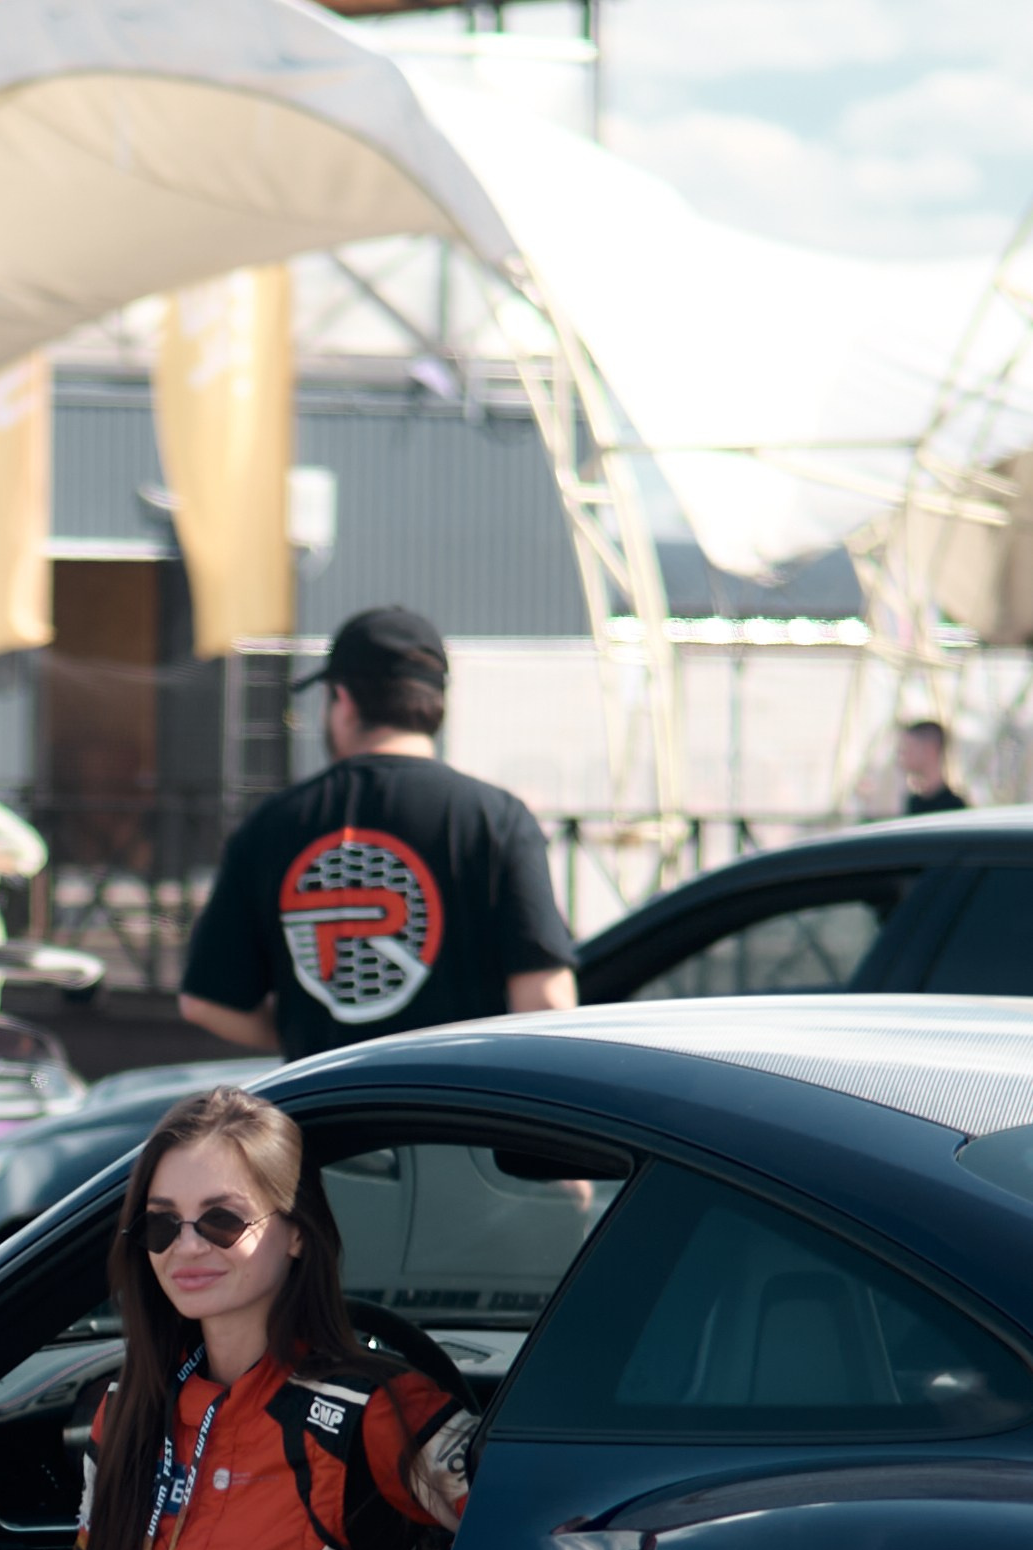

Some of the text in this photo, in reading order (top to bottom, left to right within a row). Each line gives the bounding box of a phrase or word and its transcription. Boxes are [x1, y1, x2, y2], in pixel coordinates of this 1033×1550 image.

[183, 1405, 216, 1505] UNLIM FEST
[309, 1400, 345, 1429] OMP
[147, 1436, 174, 1537] UNLIM FEST
